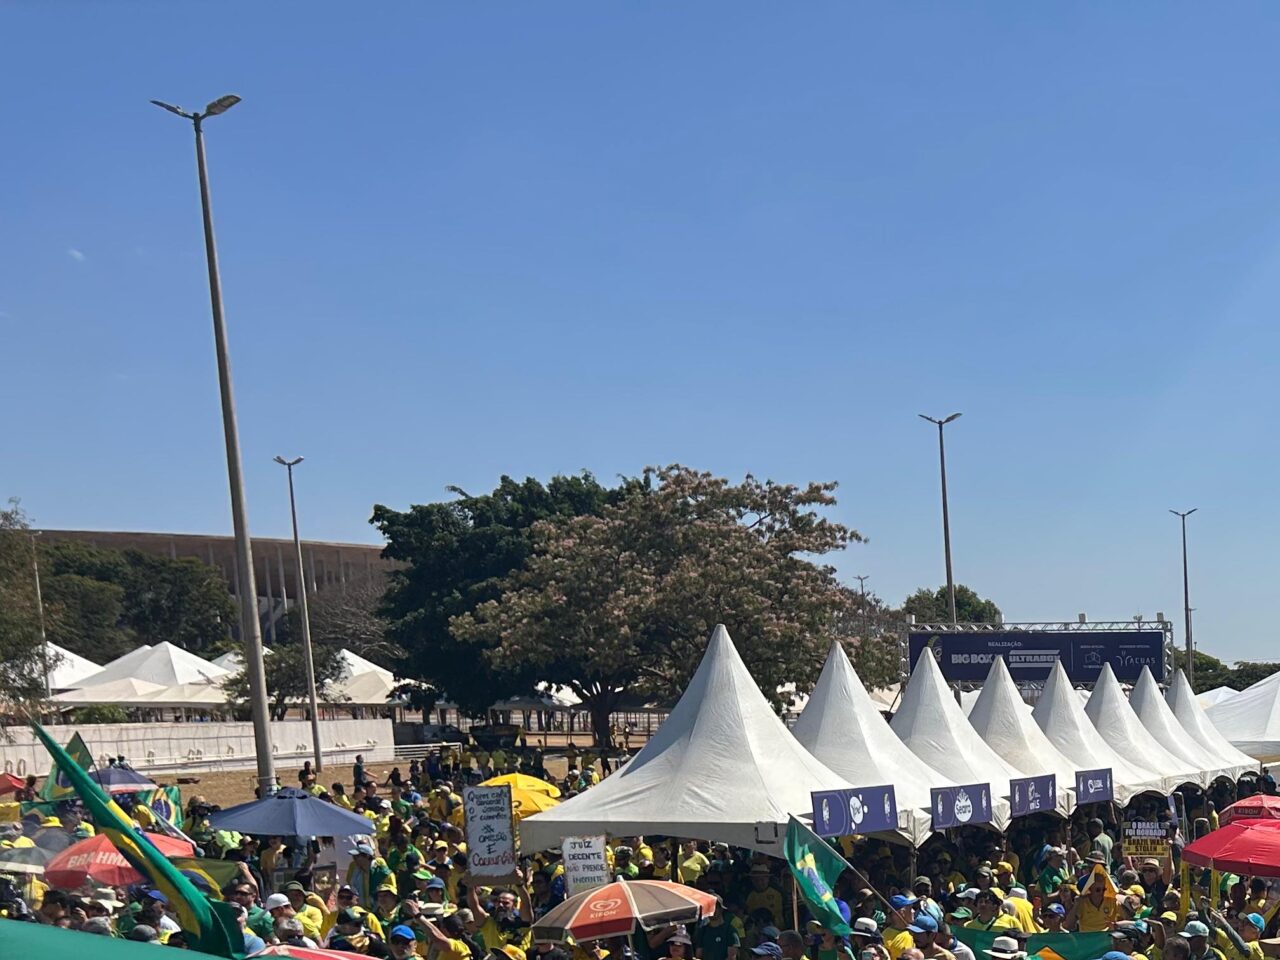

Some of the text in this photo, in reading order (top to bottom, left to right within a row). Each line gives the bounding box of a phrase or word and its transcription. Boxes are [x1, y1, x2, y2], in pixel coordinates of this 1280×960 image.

[951, 654, 970, 664] BIG
[1009, 655, 1061, 663] ULTRABOX
[954, 804, 974, 817] Seara
[1137, 822, 1160, 830] BRASIL
[1127, 838, 1149, 847] BRAZIL
[567, 853, 603, 861] DECENTE
